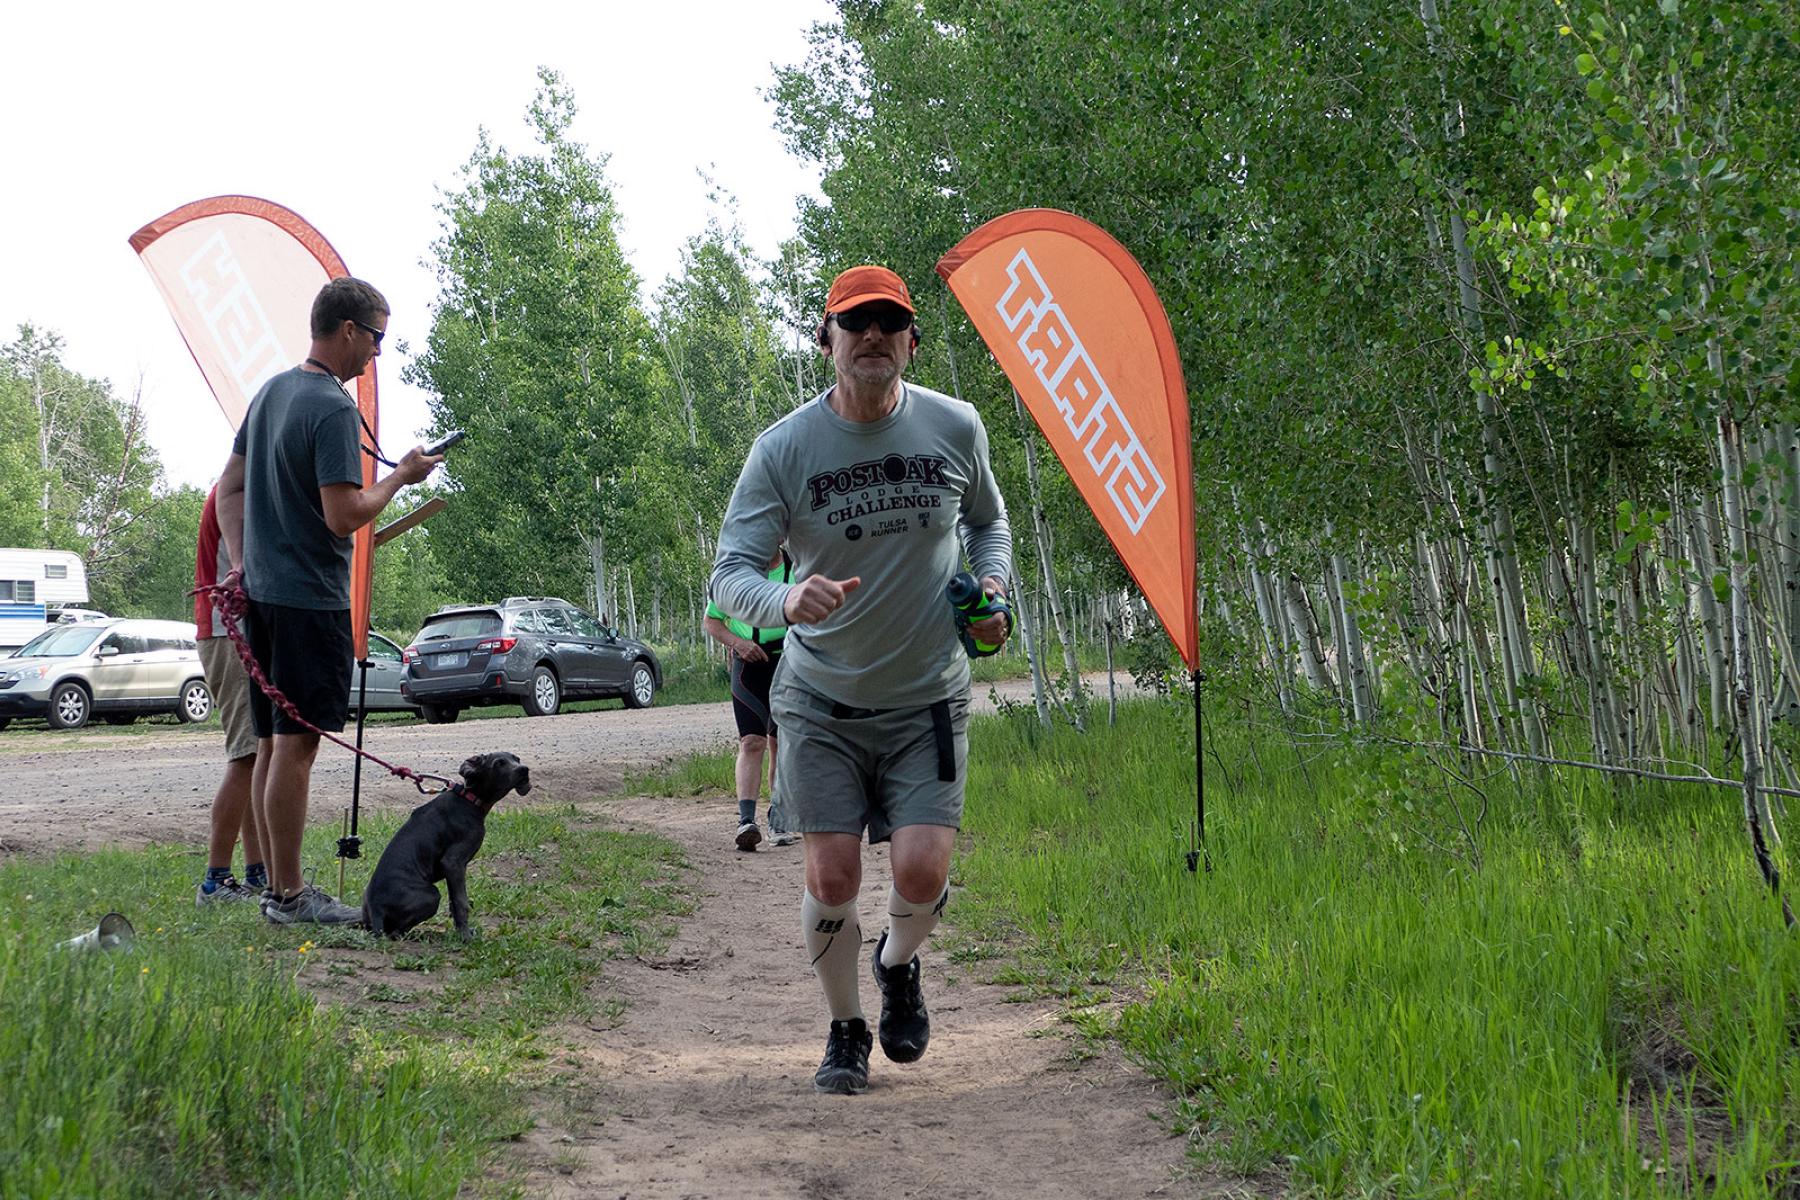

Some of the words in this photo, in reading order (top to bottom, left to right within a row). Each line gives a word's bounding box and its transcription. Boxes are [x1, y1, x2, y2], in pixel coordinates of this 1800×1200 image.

[846, 486, 920, 504] LODGE
[827, 495, 941, 525] CHALLENGE
[878, 518, 907, 529] TULSA
[871, 526, 909, 538] RUNNER
